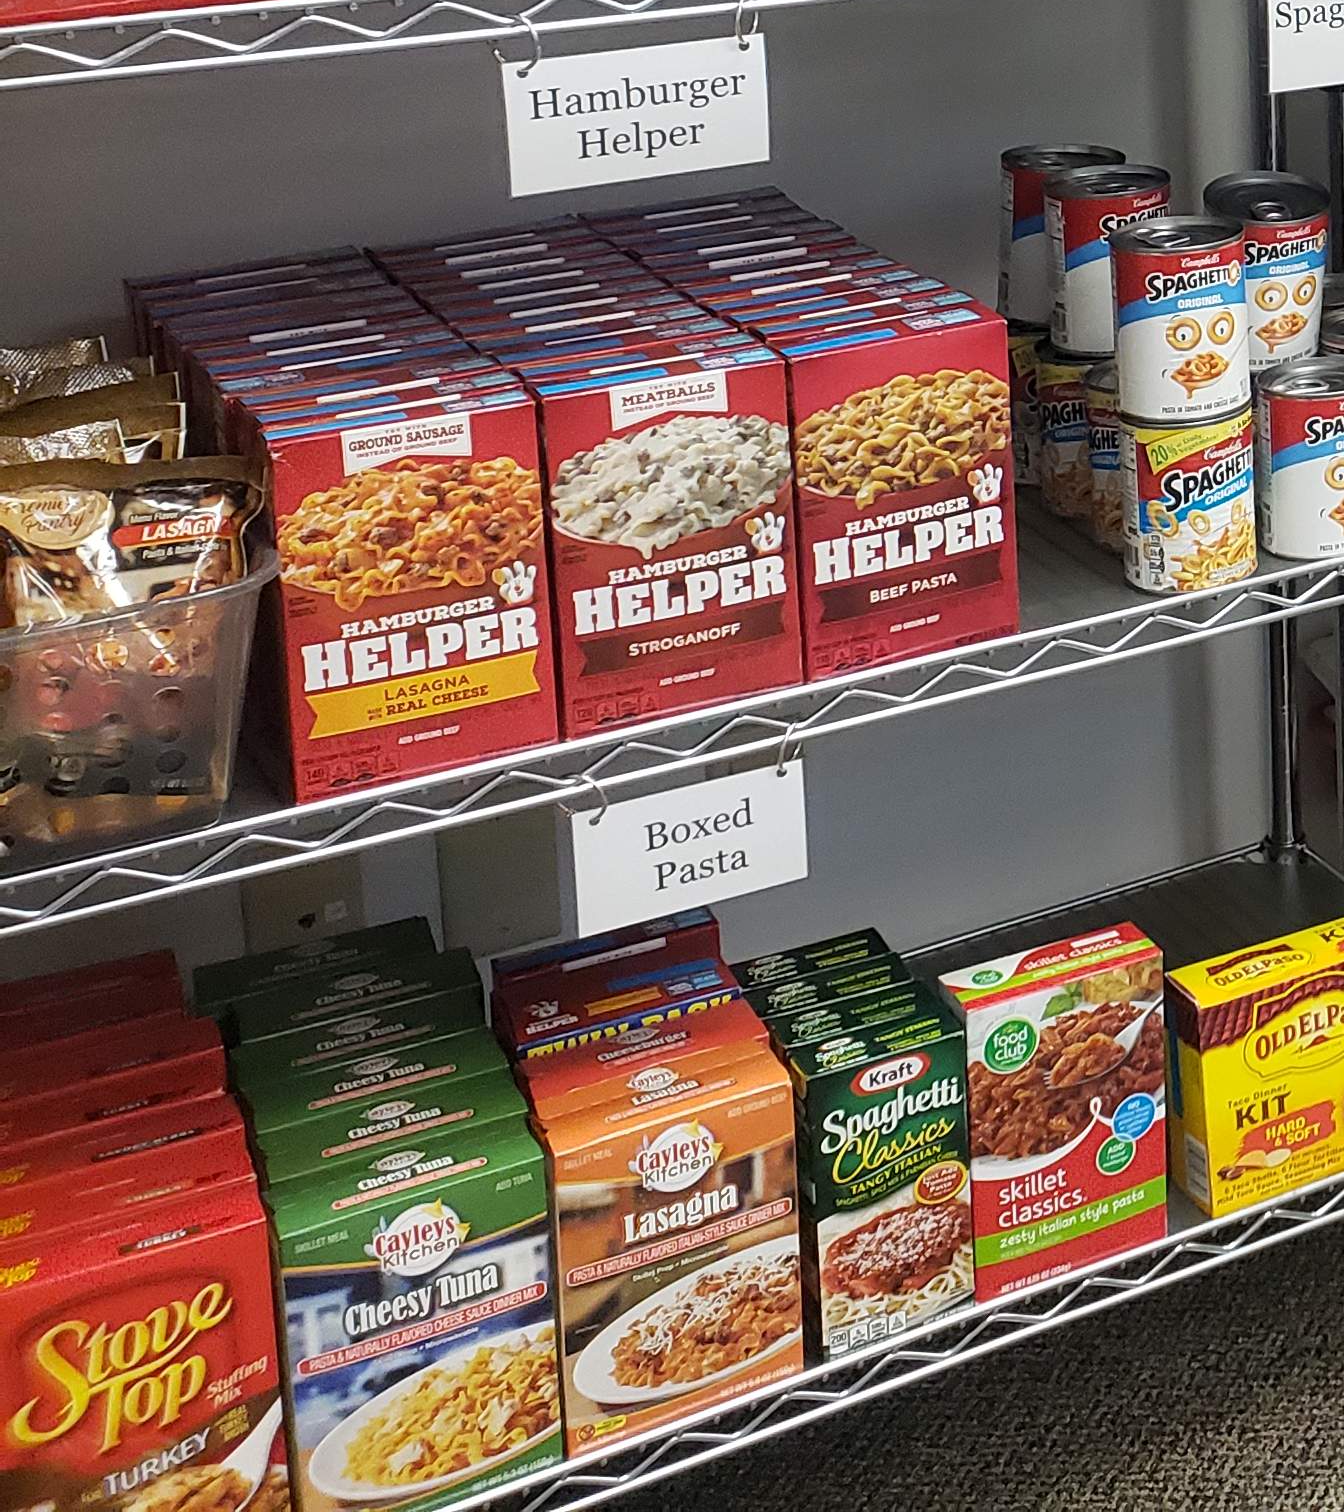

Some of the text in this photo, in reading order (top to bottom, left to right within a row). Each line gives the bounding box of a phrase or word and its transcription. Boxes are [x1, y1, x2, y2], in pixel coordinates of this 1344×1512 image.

[528, 73, 746, 120] Hamburger
[577, 121, 705, 159] Helper
[1178, 294, 1223, 308] ORIGINAL
[621, 382, 716, 407] MEATBALLS
[348, 423, 465, 454] GROUND SAUSAGE
[573, 554, 787, 636] HELPER
[870, 572, 957, 604] BEEF PASTA
[340, 596, 495, 640] HAMBURGER
[302, 606, 540, 693] HELPER
[629, 622, 741, 657] STROGANOFF
[384, 674, 470, 702] LASAGNA
[644, 797, 755, 852] Boxed
[654, 849, 750, 891] Pasta
[993, 1027, 1029, 1051] food
[868, 1064, 915, 1087] Kraft
[821, 1077, 962, 1154] Spaghetti
[1228, 1084, 1289, 1110] Taco Dinner
[1235, 1091, 1291, 1130] KIT
[1266, 1116, 1307, 1140] HARD
[1286, 1123, 1321, 1144] SOFT
[999, 1168, 1067, 1206] skillet
[624, 1183, 739, 1244] Lasagna
[374, 1215, 456, 1258] Cayleys
[344, 1263, 499, 1337] Cheesy Tuna
[104, 1427, 210, 1498] TURKEY
